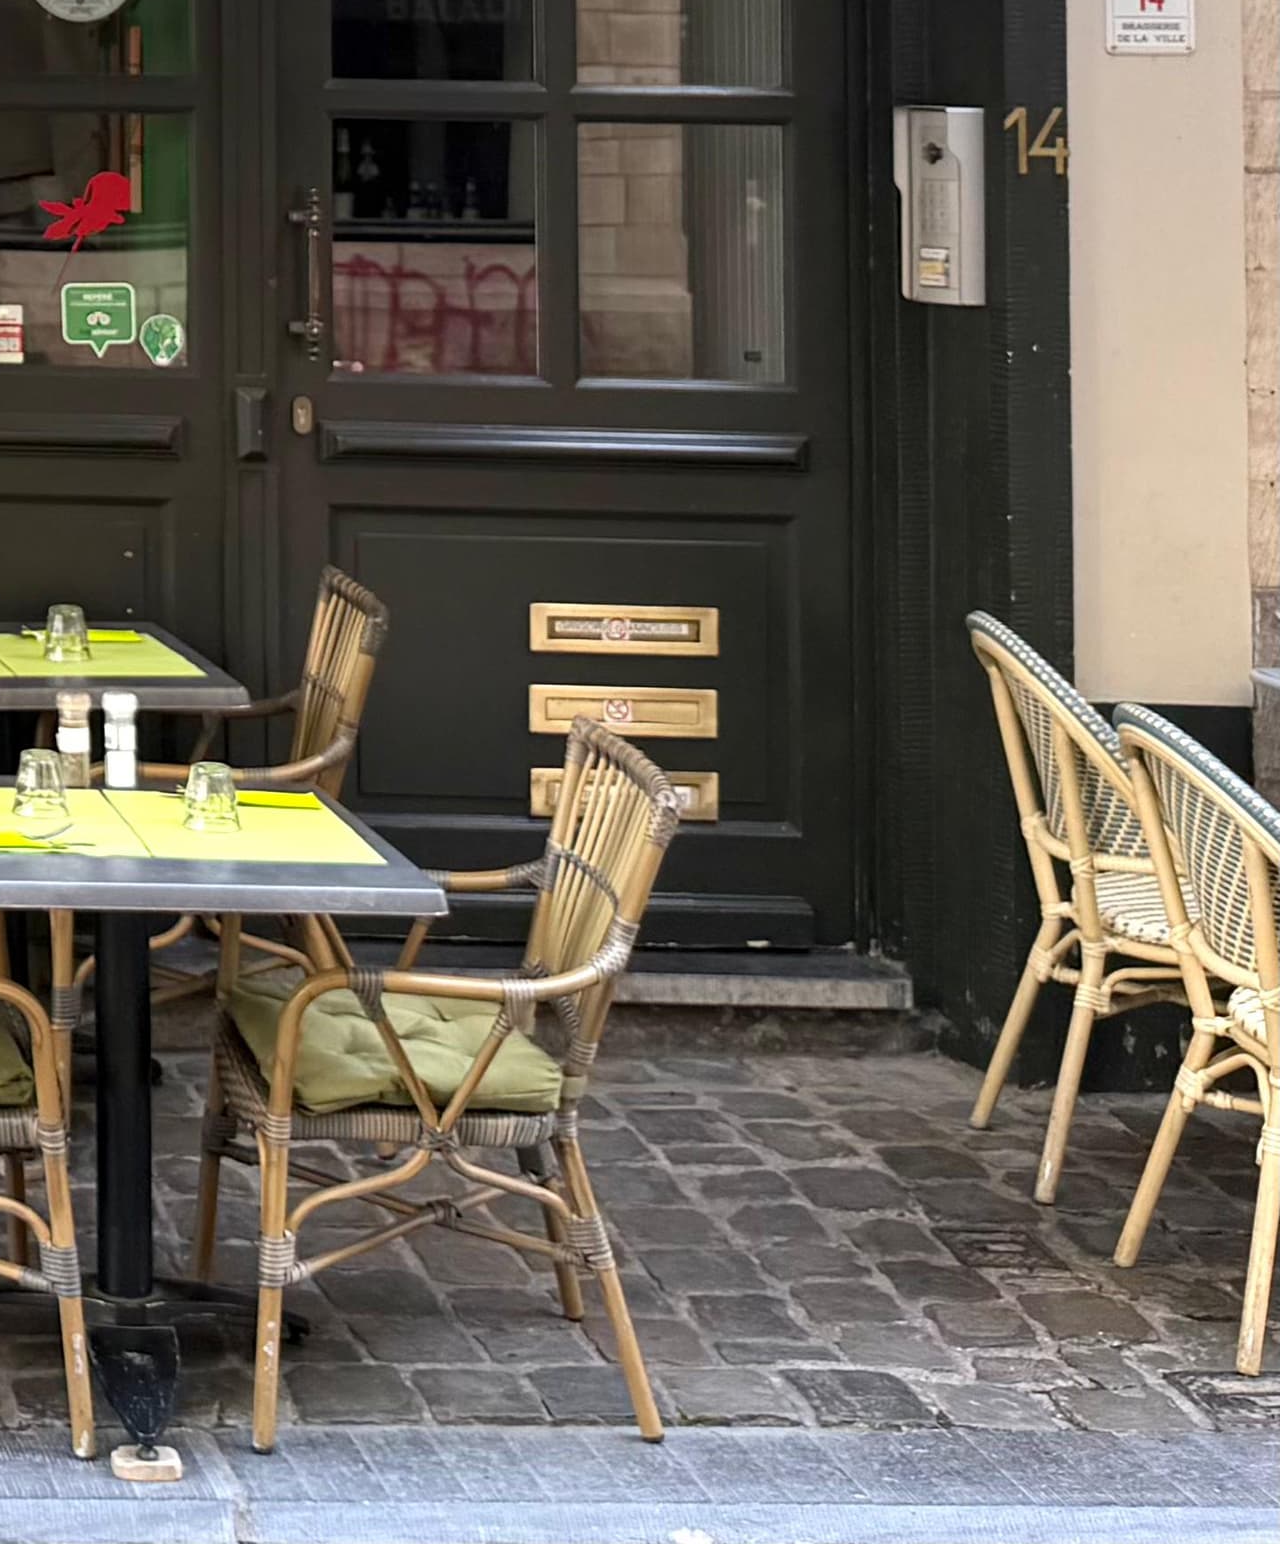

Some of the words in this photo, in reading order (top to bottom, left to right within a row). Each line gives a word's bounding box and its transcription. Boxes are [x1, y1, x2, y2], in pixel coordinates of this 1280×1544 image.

[1121, 21, 1181, 31] BRASSERIE
[1117, 34, 1131, 43] DE
[1133, 34, 1148, 43] LA
[1155, 34, 1186, 43] VILLE
[1003, 107, 1071, 175] 14
